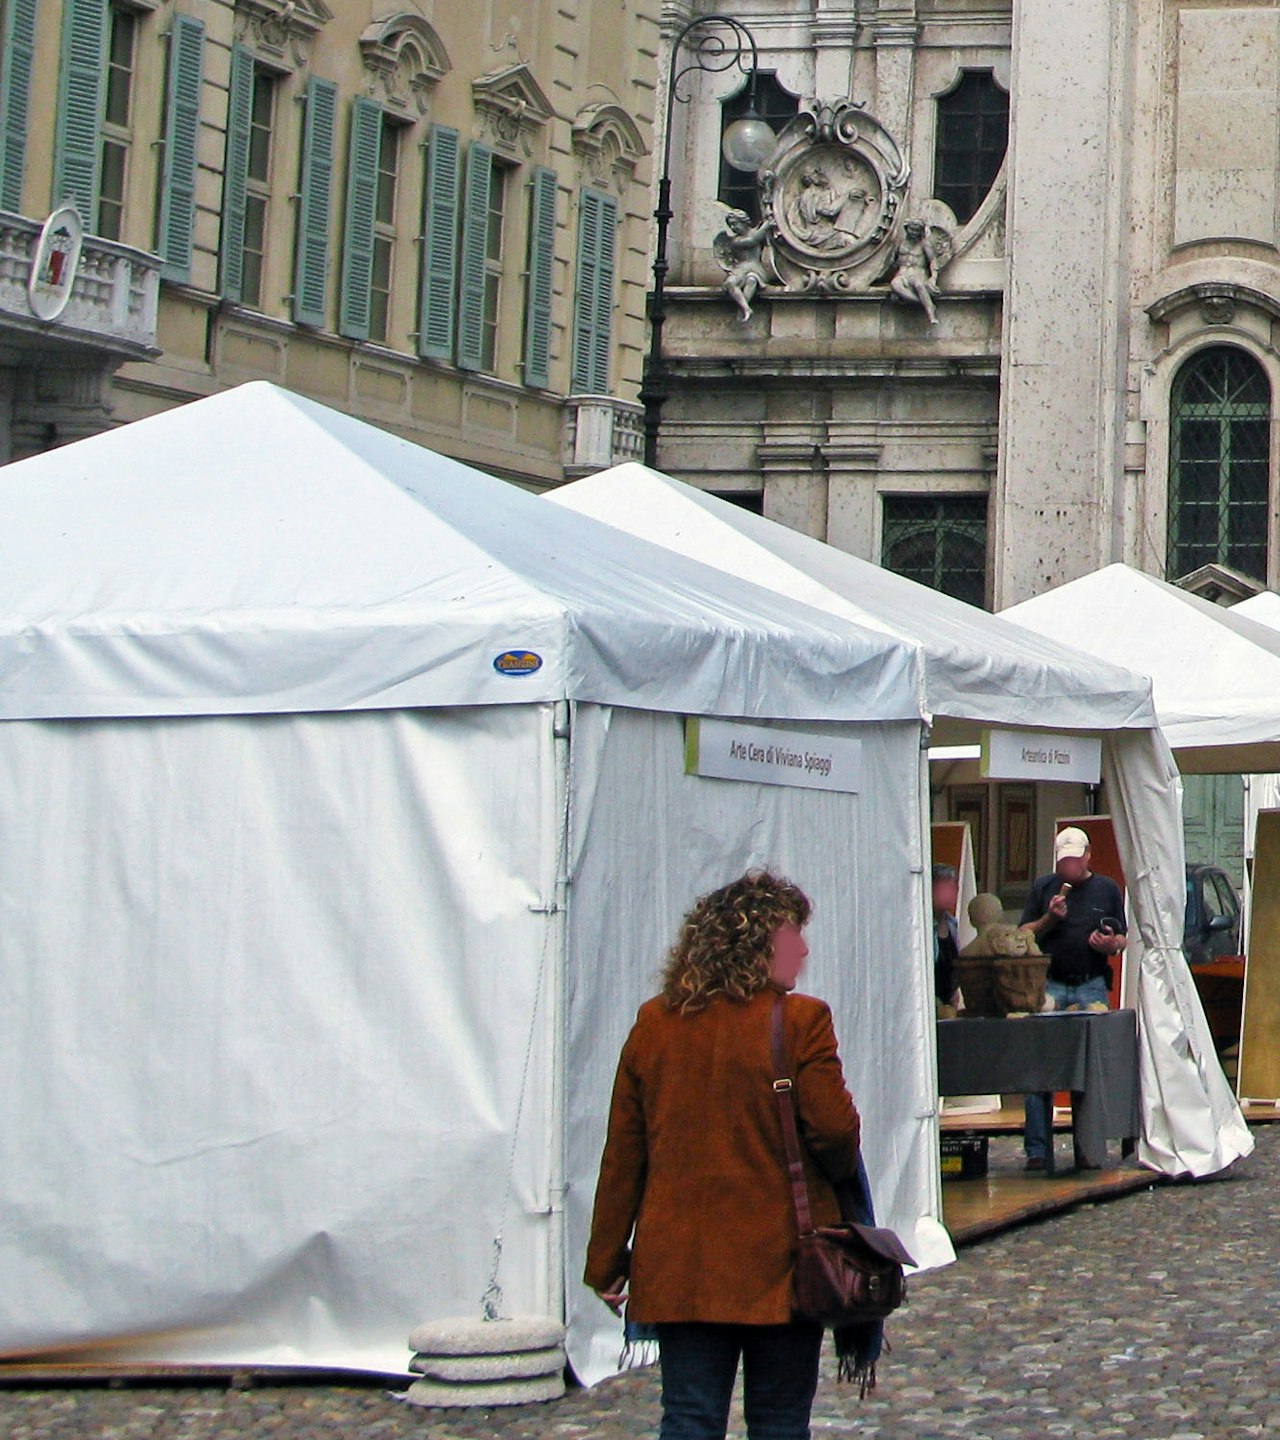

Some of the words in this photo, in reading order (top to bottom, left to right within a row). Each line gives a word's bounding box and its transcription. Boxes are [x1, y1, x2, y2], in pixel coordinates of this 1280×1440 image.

[730, 740, 747, 760] Arte
[748, 743, 765, 762] Cera
[766, 746, 775, 764] di
[775, 747, 802, 768] Viviana
[804, 752, 832, 776] Spiaggi
